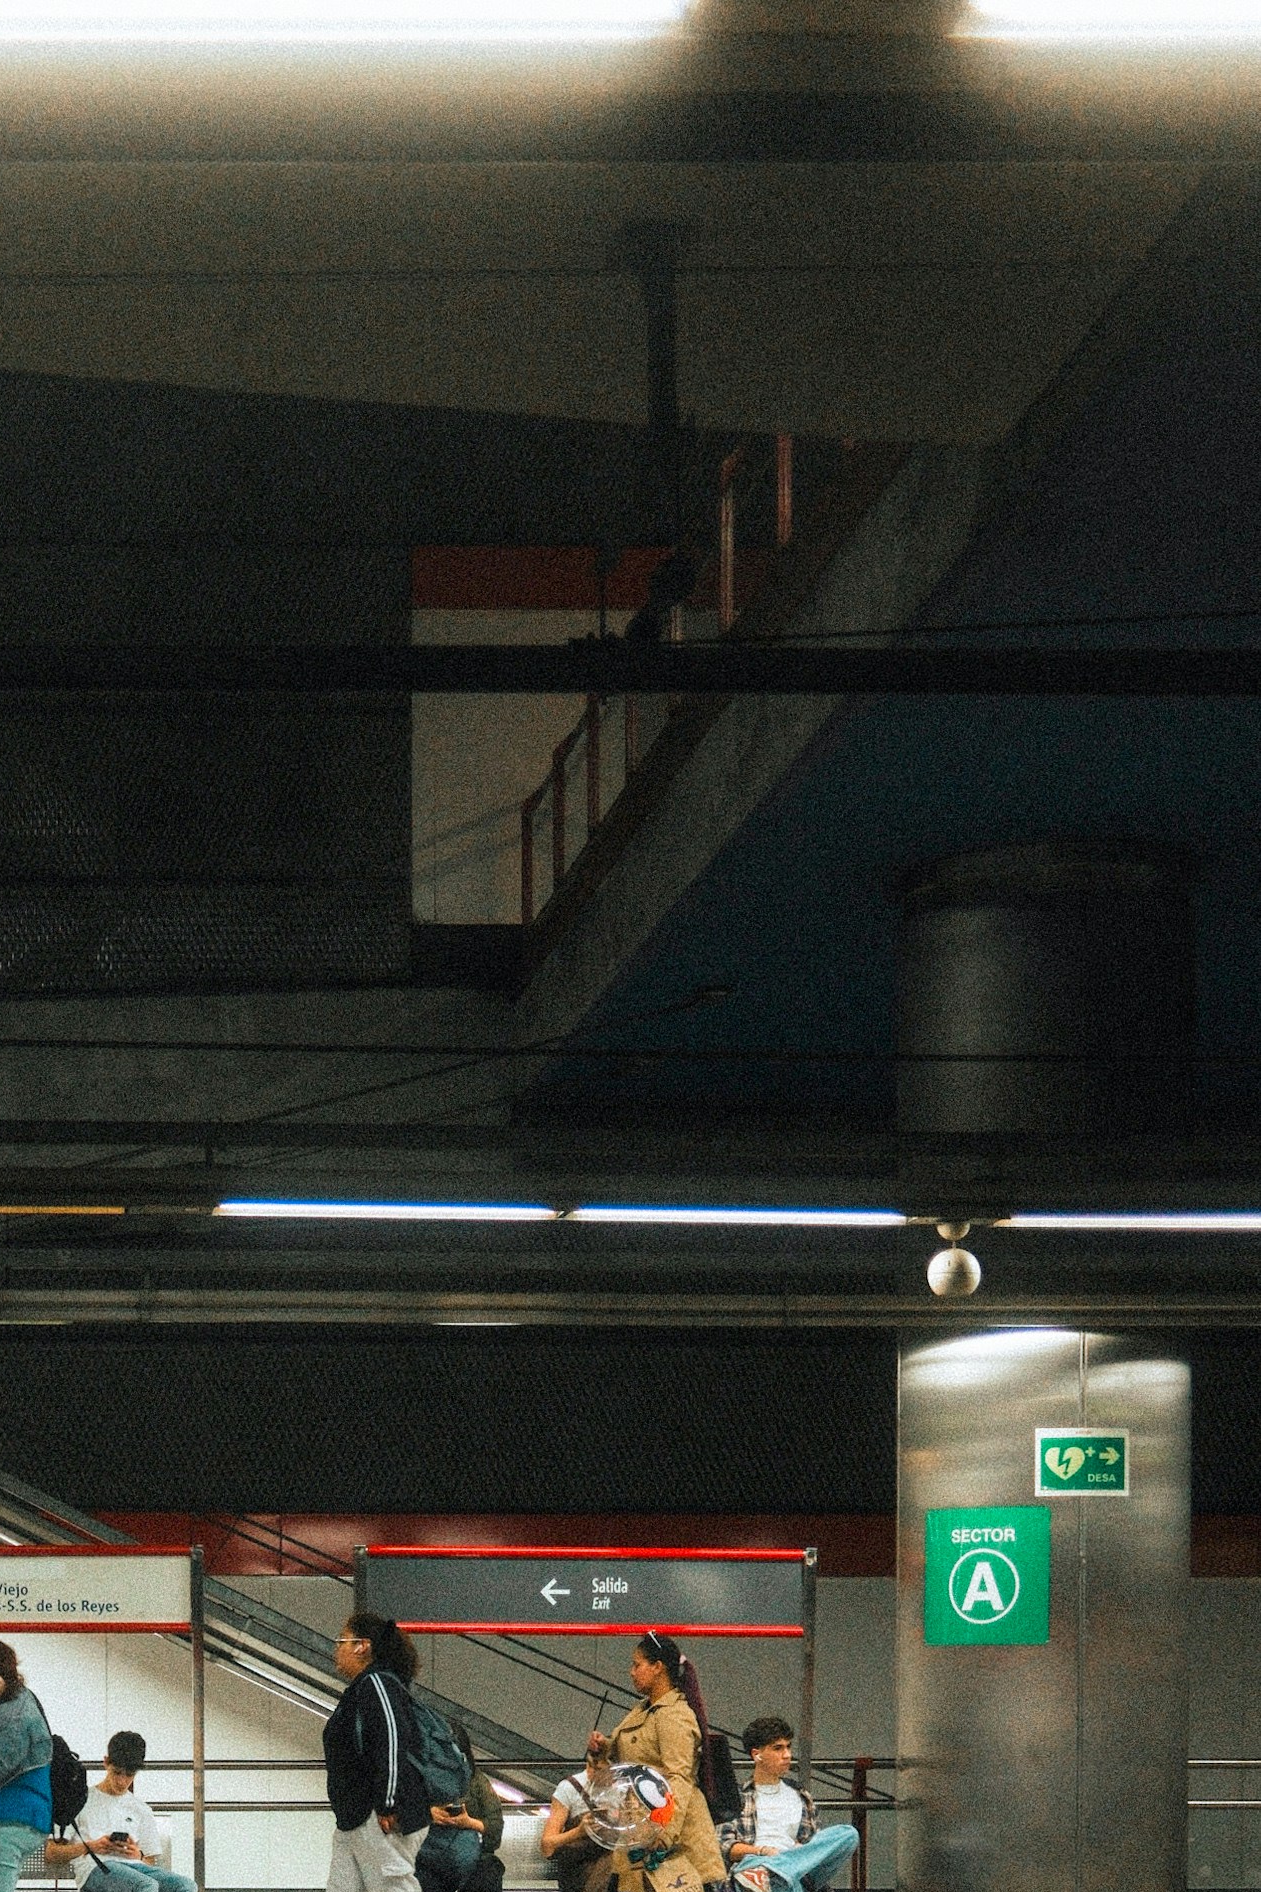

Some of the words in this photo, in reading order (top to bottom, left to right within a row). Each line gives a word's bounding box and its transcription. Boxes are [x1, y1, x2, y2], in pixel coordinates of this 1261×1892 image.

[1087, 1473, 1117, 1483] DESA
[951, 1527, 1016, 1544] SECTOR
[591, 1576, 629, 1594] Salida
[961, 1561, 1005, 1611] A
[36, 1599, 53, 1613] de
[57, 1599, 77, 1613] los
[81, 1600, 120, 1616] Reyes
[591, 1596, 611, 1610] Exit
